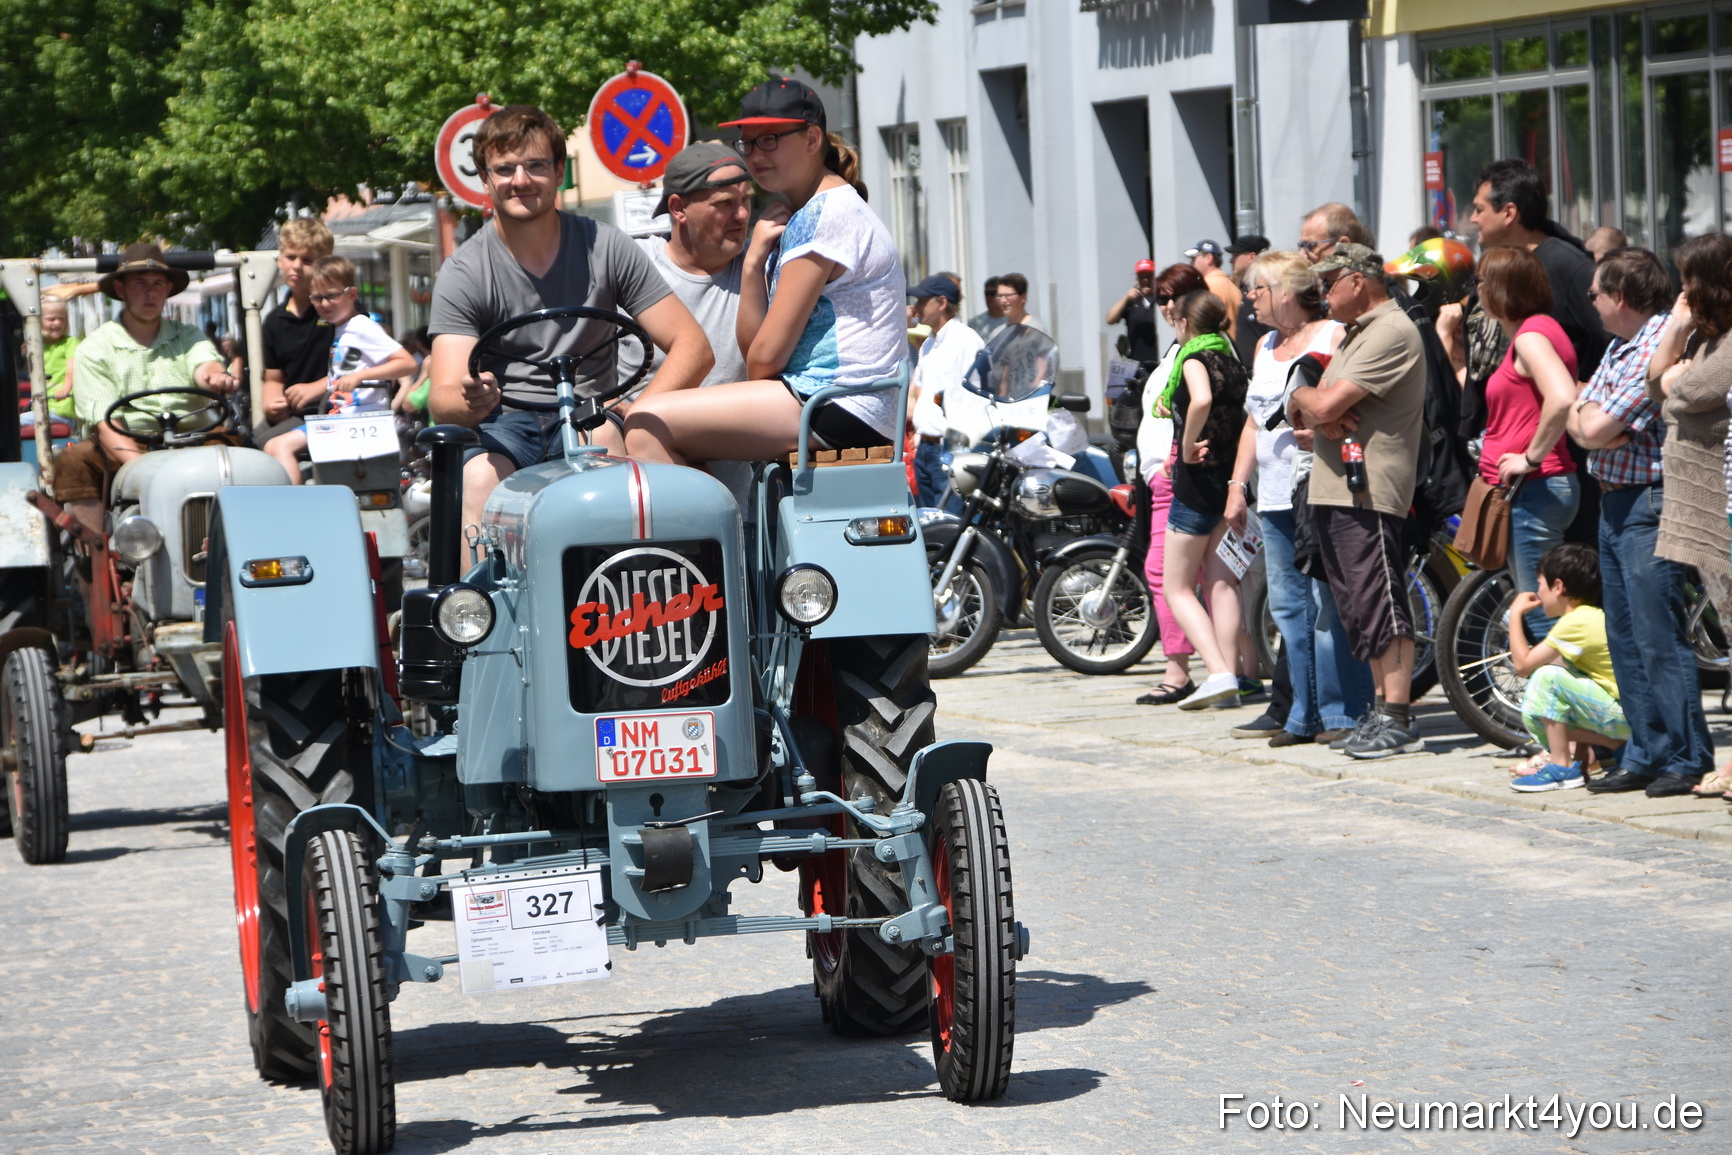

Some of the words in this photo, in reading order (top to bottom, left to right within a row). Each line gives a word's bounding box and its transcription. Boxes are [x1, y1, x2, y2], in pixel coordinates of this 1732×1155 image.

[349, 427, 378, 439] 212
[569, 582, 724, 649] Eicher
[597, 567, 697, 667] DIESEL
[661, 657, 728, 704] luftgekühlt
[603, 736, 611, 745] D
[621, 720, 659, 748] NM
[613, 746, 703, 777] 07031
[525, 891, 573, 918] 327
